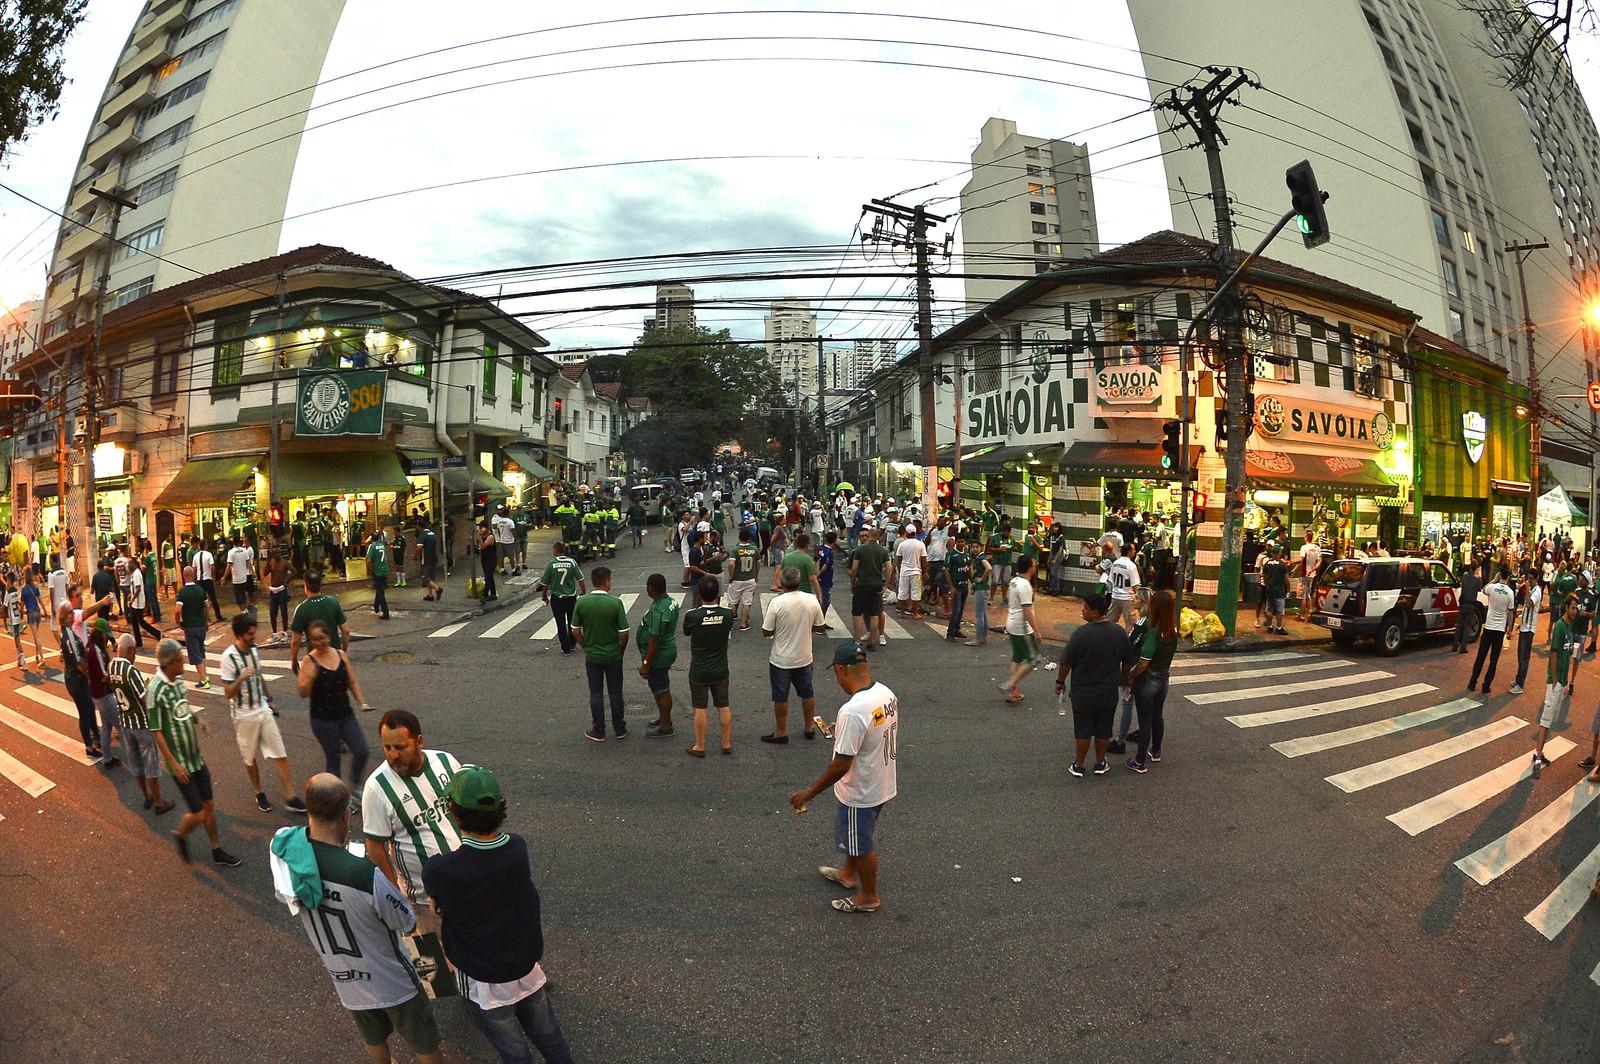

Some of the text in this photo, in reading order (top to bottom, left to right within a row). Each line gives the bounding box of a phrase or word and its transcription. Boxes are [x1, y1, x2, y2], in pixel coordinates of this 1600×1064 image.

[1098, 370, 1159, 388] SAVÓIA
[350, 382, 382, 413] SOU
[968, 376, 1065, 438] SAVÓIA
[303, 398, 350, 430] PALMEIRAS
[1291, 408, 1368, 440] SAVÓIA
[378, 549, 385, 562] 7
[740, 556, 754, 572] 10
[557, 567, 568, 586] 7
[1112, 572, 1124, 590] 10
[702, 615, 724, 623] CASE
[115, 687, 131, 711] 9
